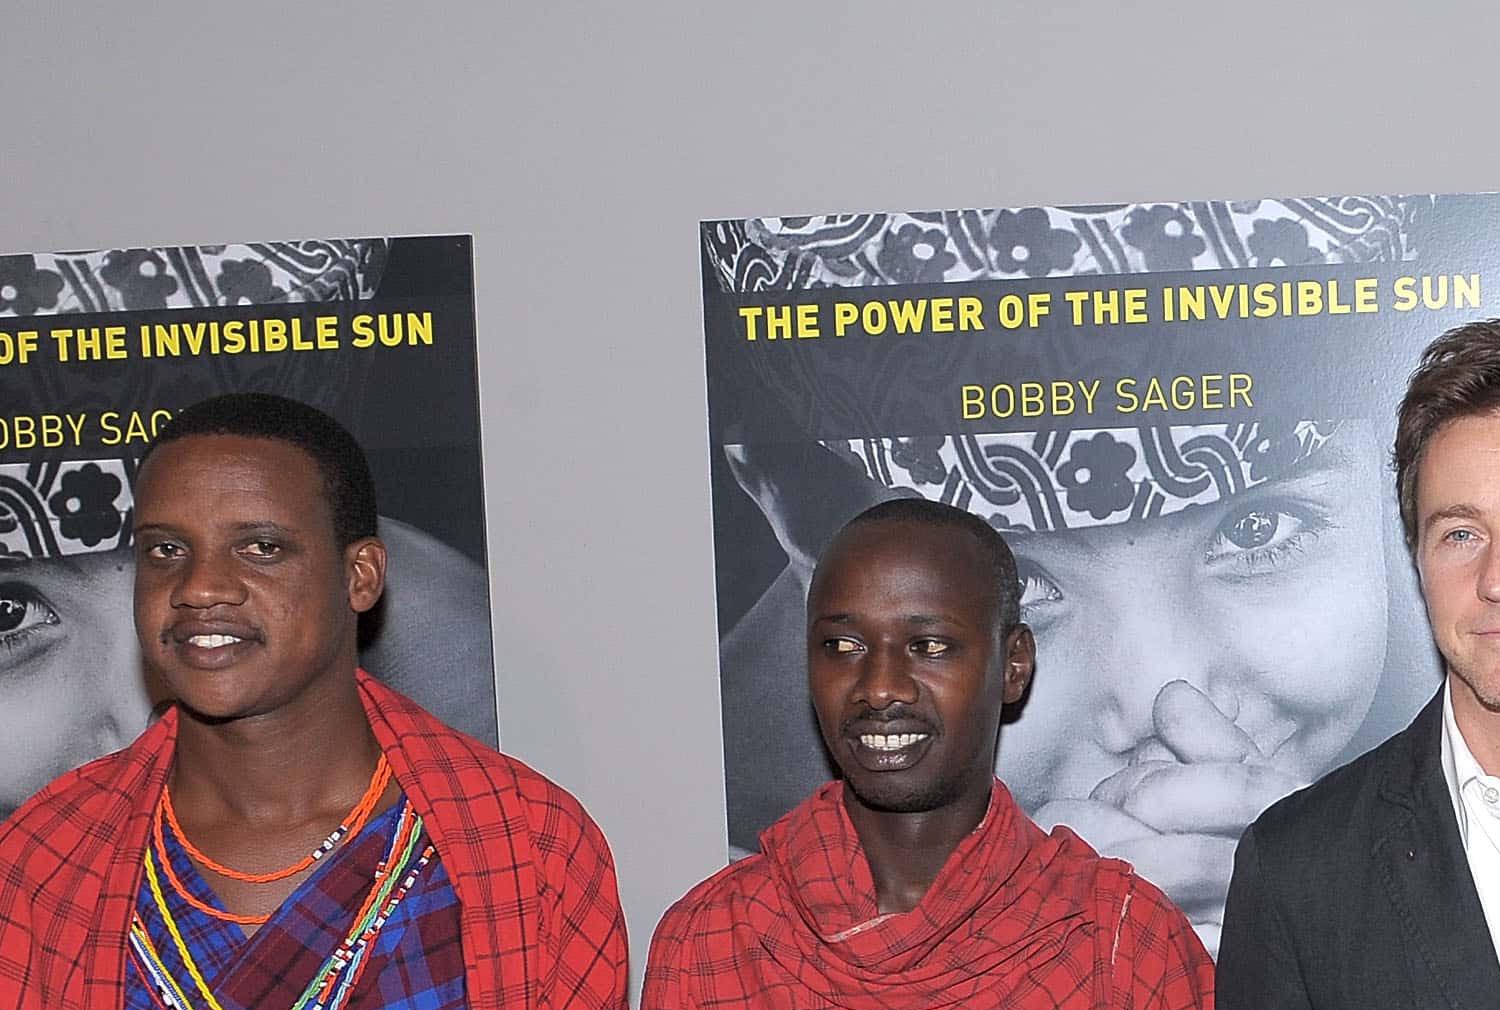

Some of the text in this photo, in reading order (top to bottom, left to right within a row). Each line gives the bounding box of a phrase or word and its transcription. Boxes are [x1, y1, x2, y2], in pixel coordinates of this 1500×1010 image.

[737, 273, 1482, 342] THE POWER OF THE INVISIBLE SUN
[49, 325, 129, 363] THE
[139, 313, 341, 359] INVISIBLE
[350, 311, 435, 349] SUN
[960, 372, 1254, 421] BOBBY SAGER
